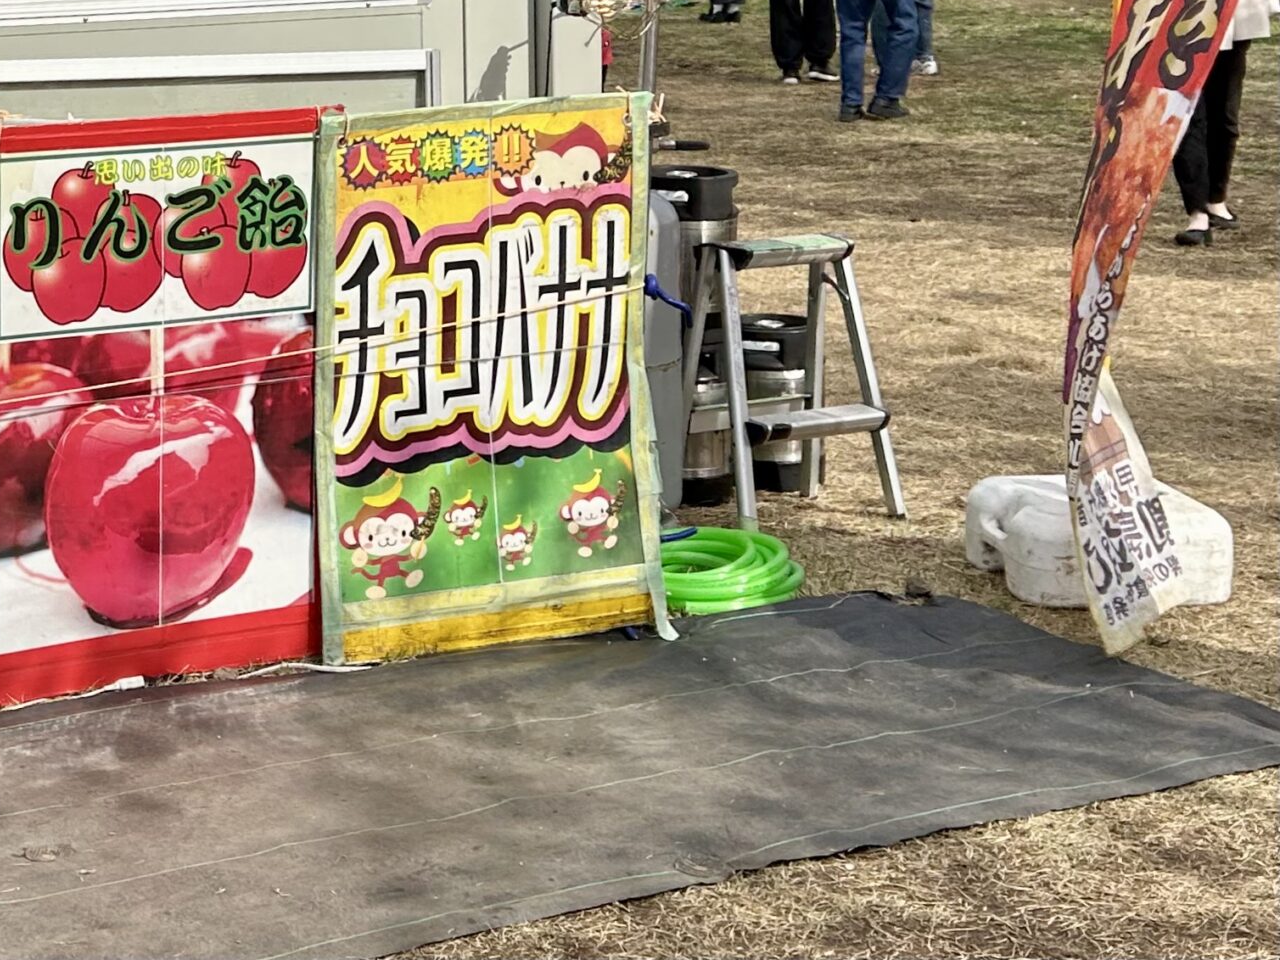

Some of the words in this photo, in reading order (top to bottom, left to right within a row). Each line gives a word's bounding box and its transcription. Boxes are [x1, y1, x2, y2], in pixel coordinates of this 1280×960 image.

[93, 151, 229, 186] 思い出の味
[349, 131, 523, 179] 人気爆発!!
[10, 174, 309, 270] りんご飴
[335, 214, 632, 442] チョコバナナ
